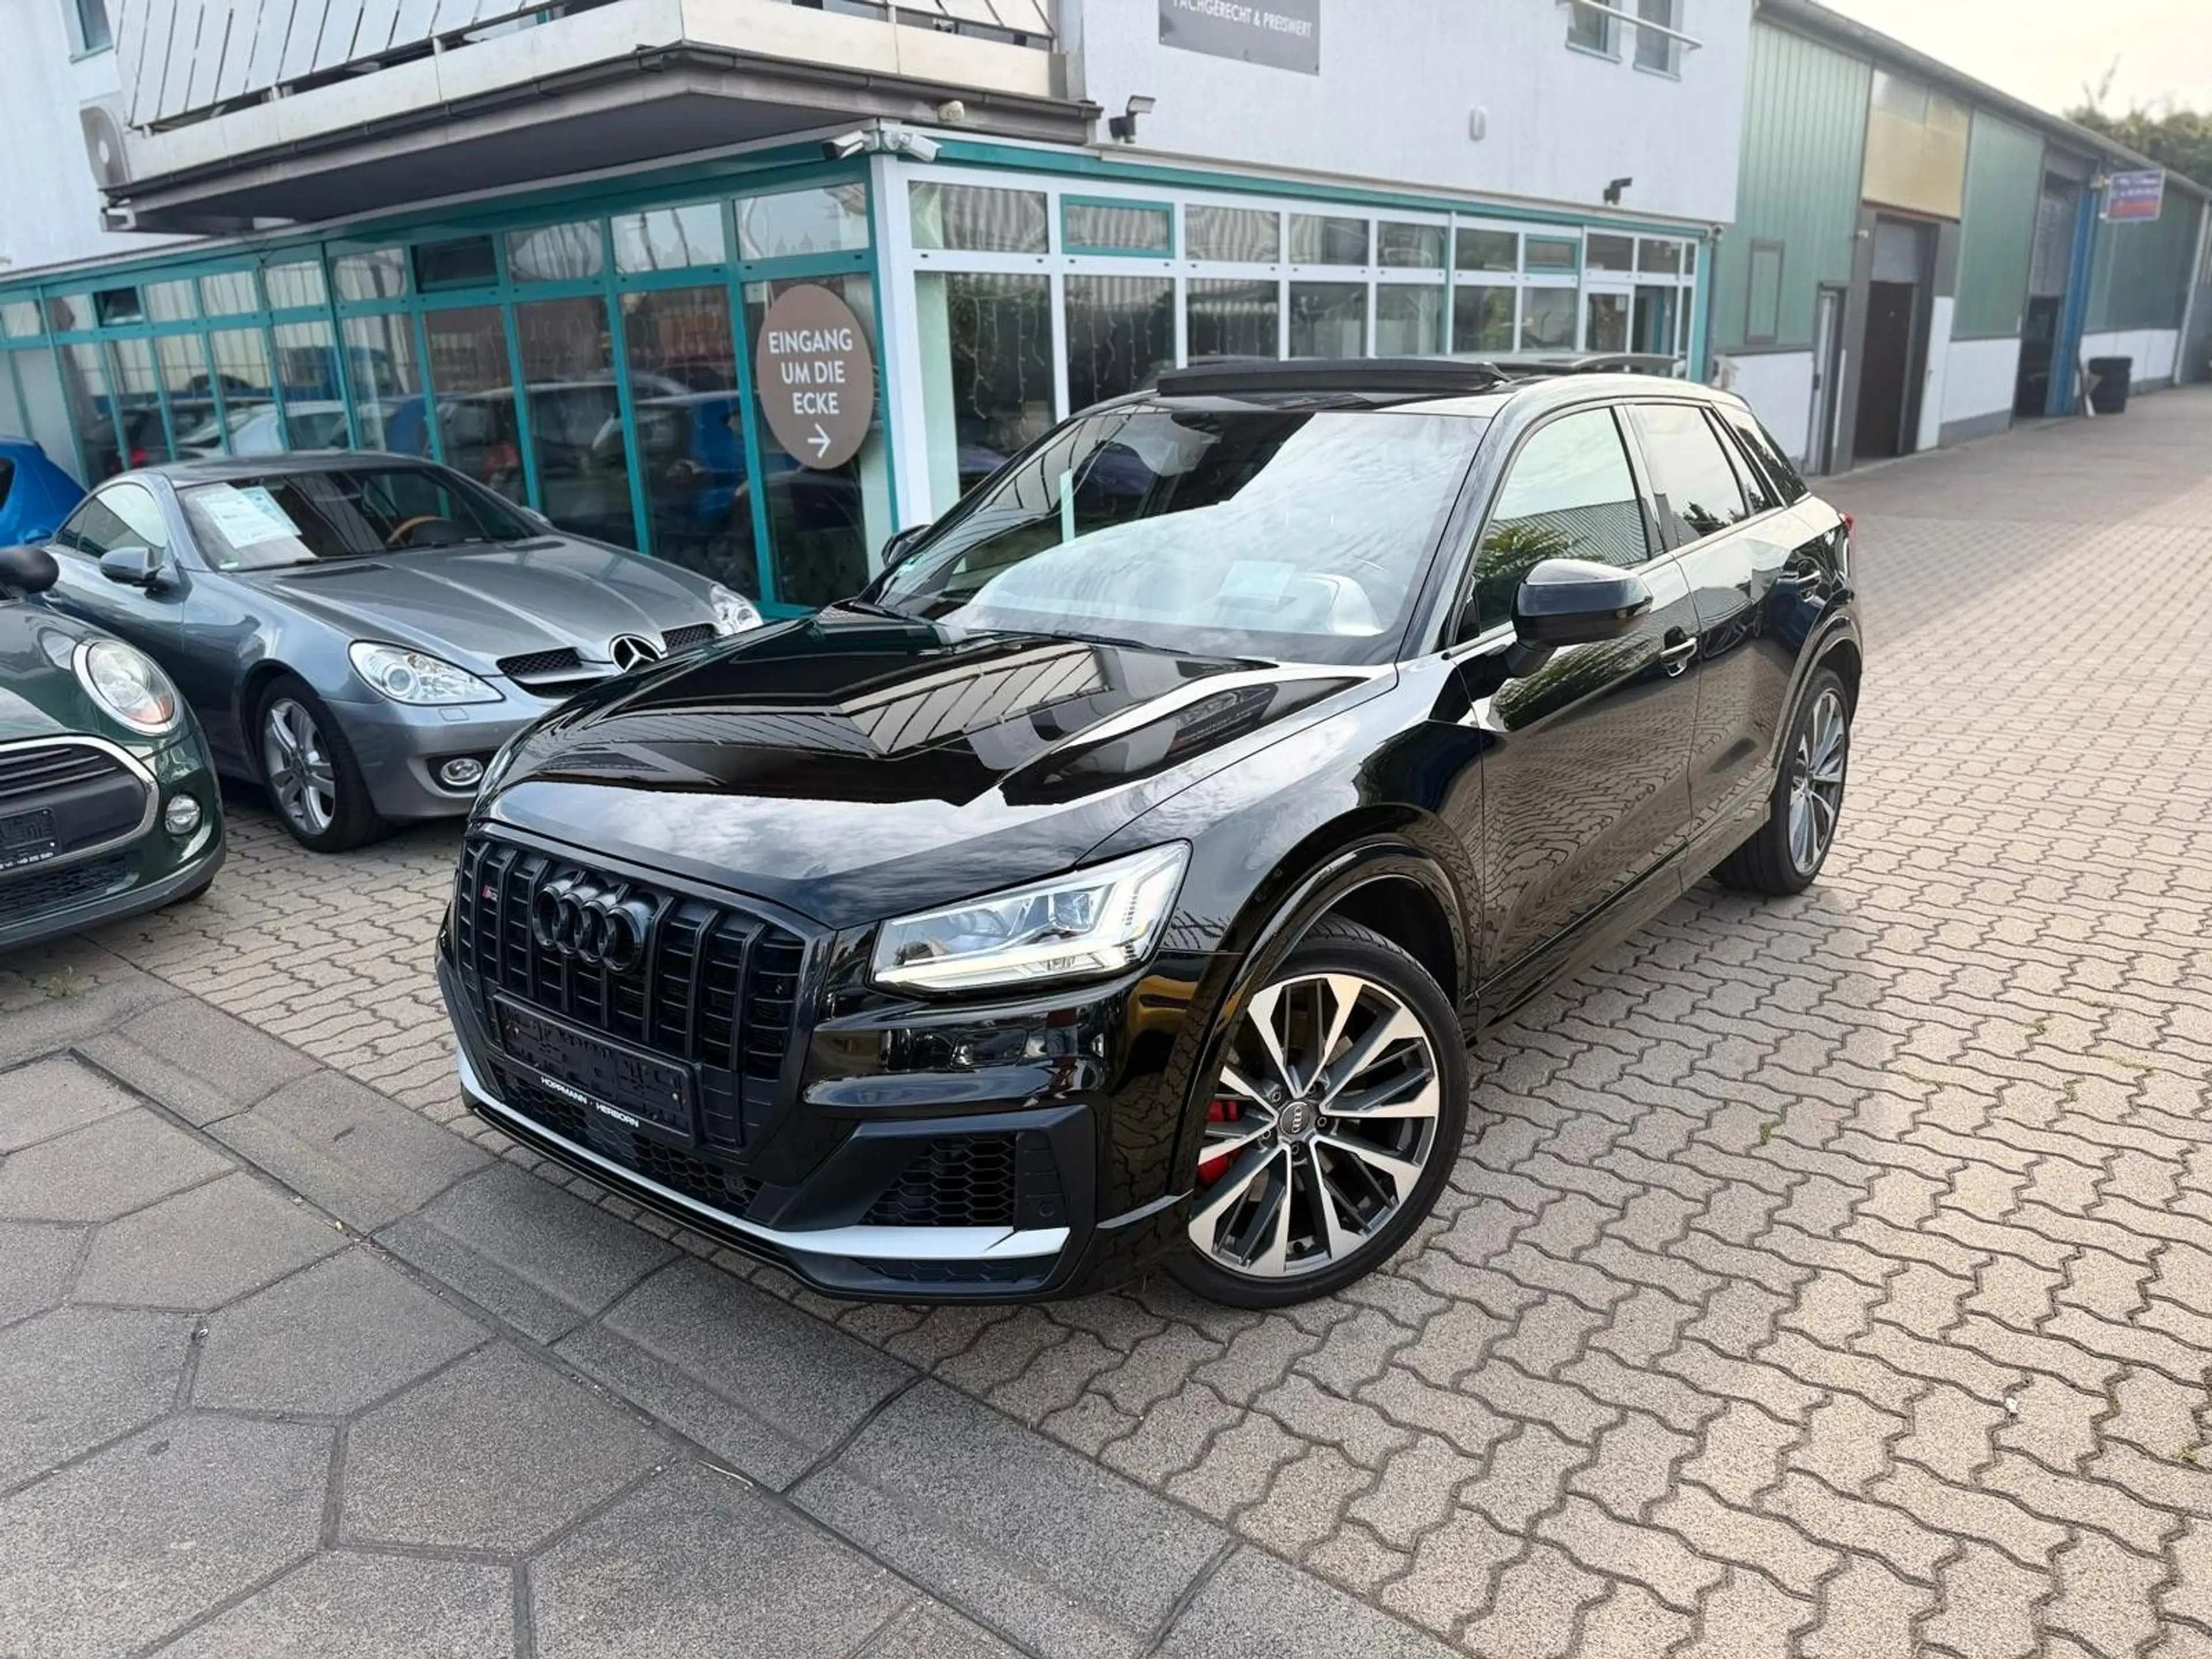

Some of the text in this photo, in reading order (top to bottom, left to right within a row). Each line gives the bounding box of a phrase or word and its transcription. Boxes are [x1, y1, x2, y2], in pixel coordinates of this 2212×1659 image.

[1252, 9, 1262, 27] &
[768, 327, 853, 354] EINGANG
[781, 360, 846, 384] UM DIE
[792, 391, 840, 415] ECKE
[596, 1101, 639, 1128] HERBORN
